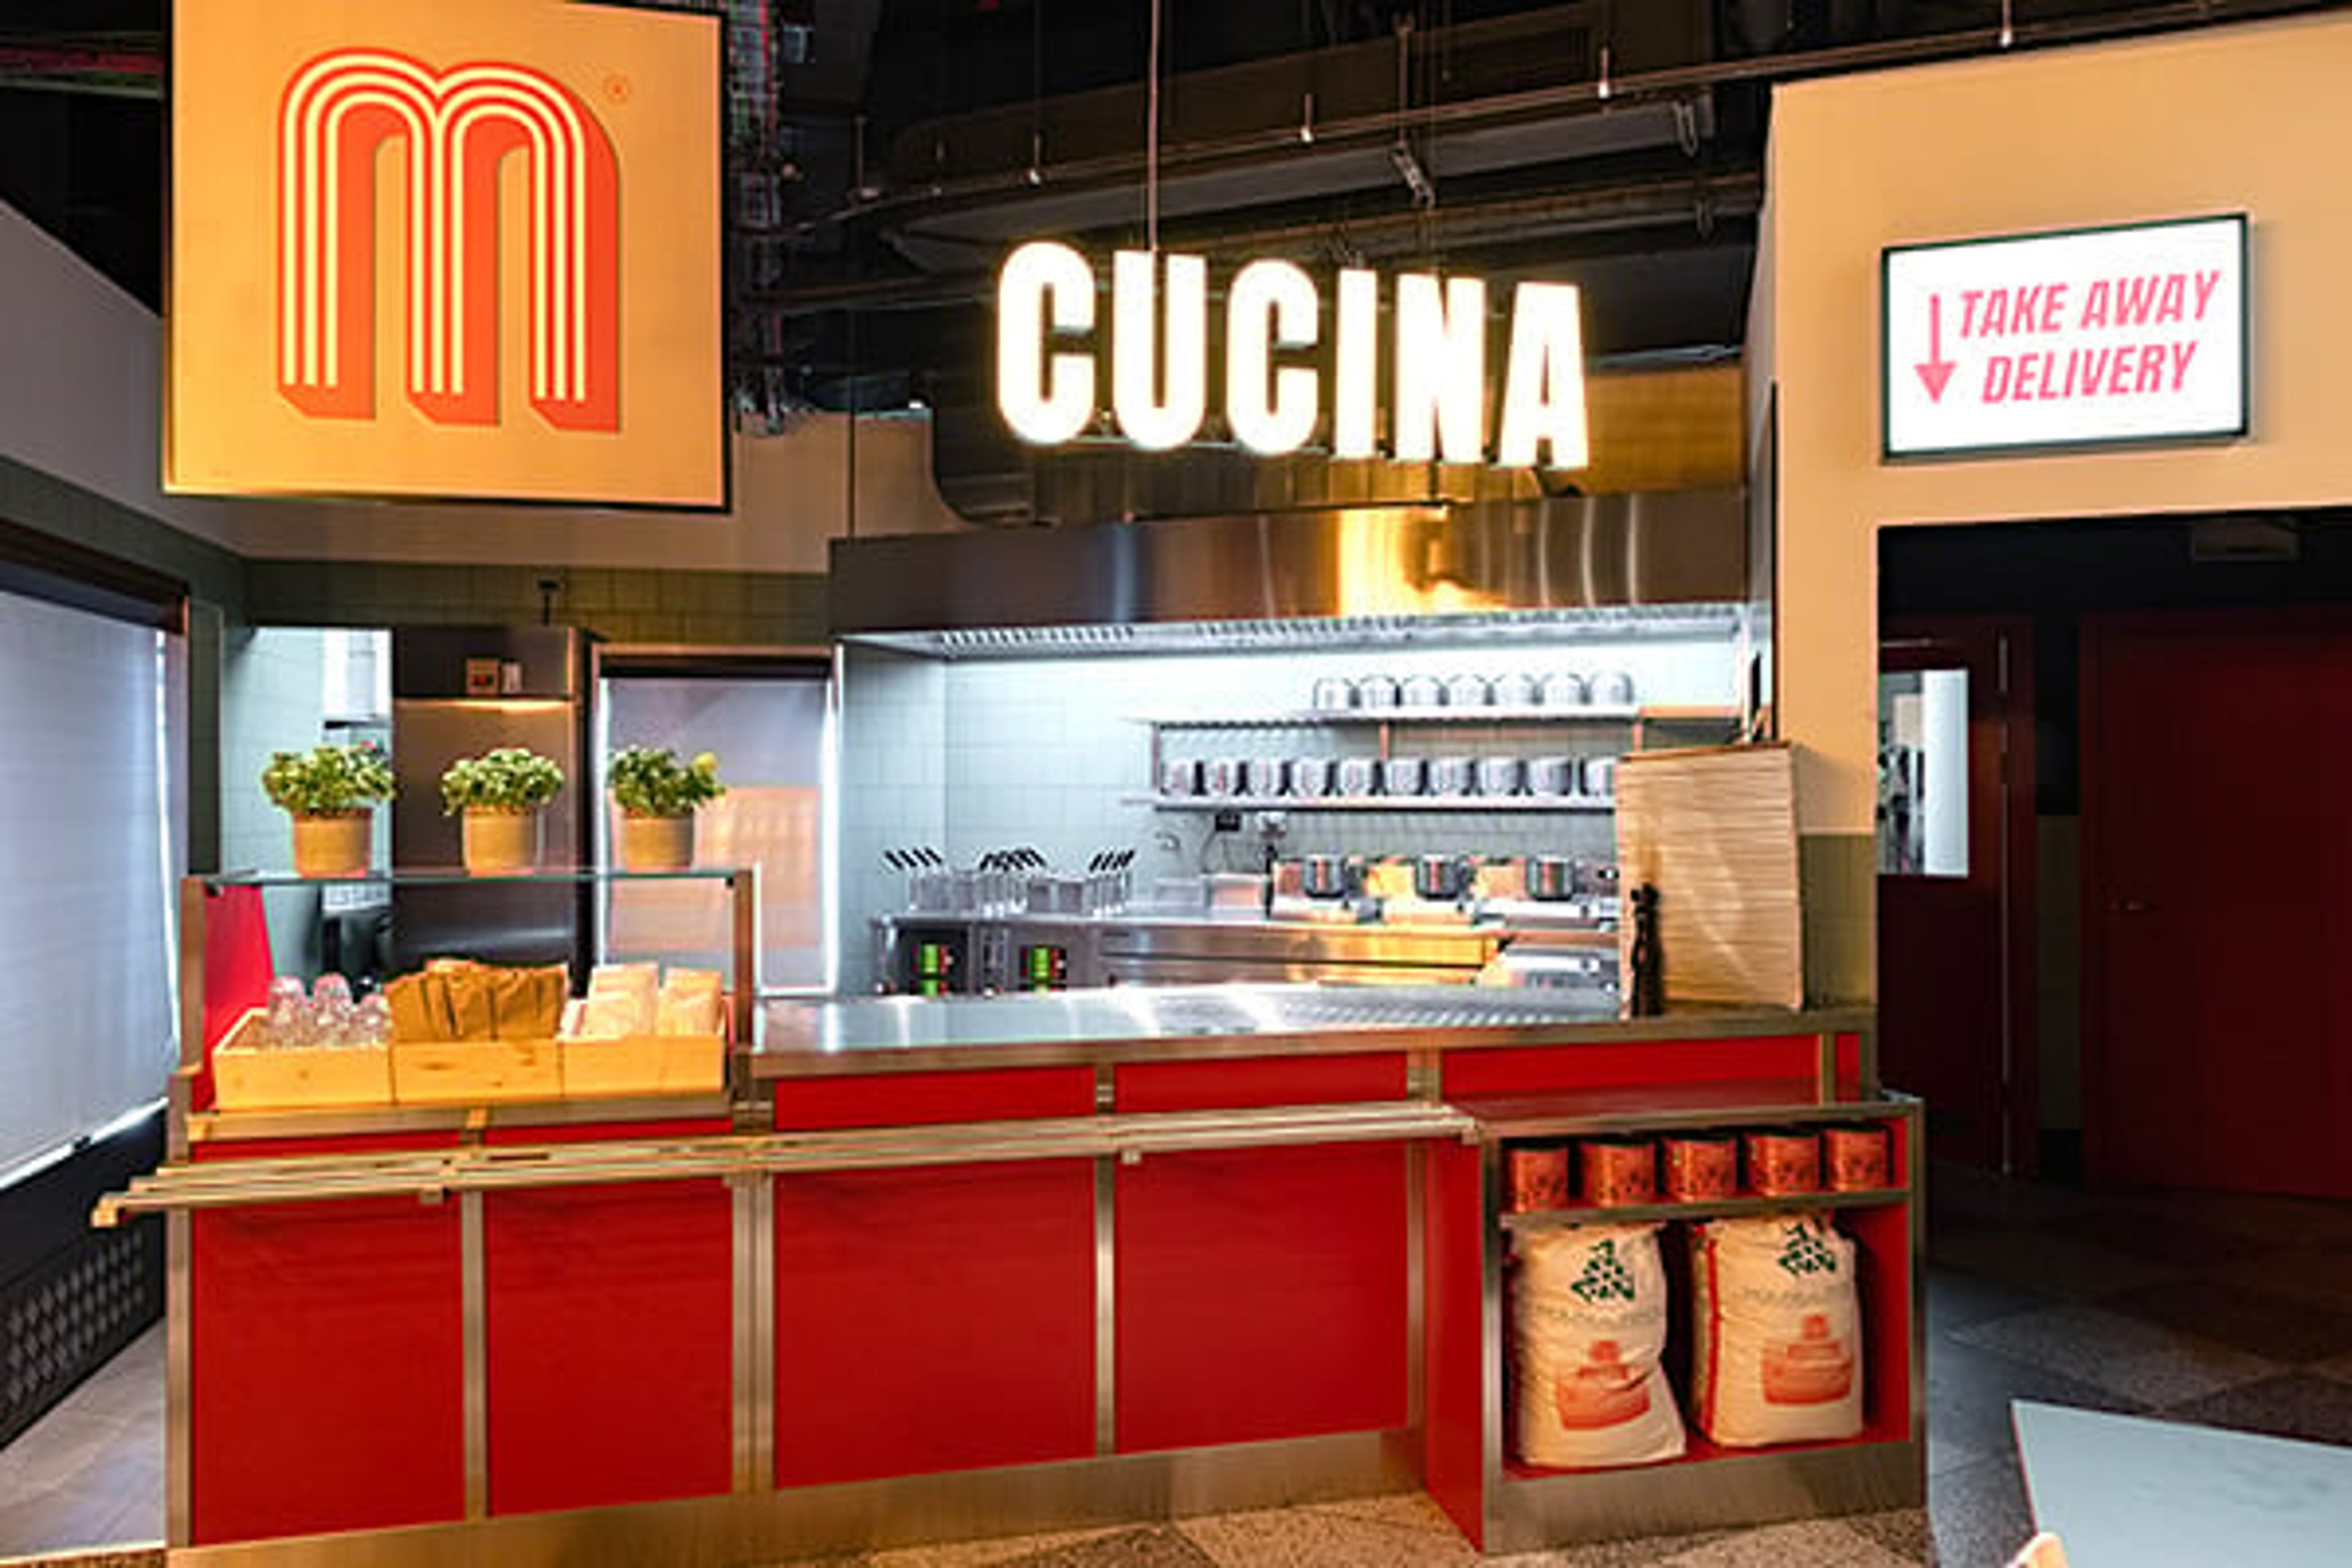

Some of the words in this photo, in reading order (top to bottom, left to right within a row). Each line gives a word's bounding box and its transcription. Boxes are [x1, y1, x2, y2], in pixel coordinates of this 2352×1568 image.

[1959, 282, 2070, 340] TAKE
[2079, 270, 2222, 331] AWAY
[998, 242, 1588, 469] CUCINA
[1981, 340, 2199, 405] DELIVERY
